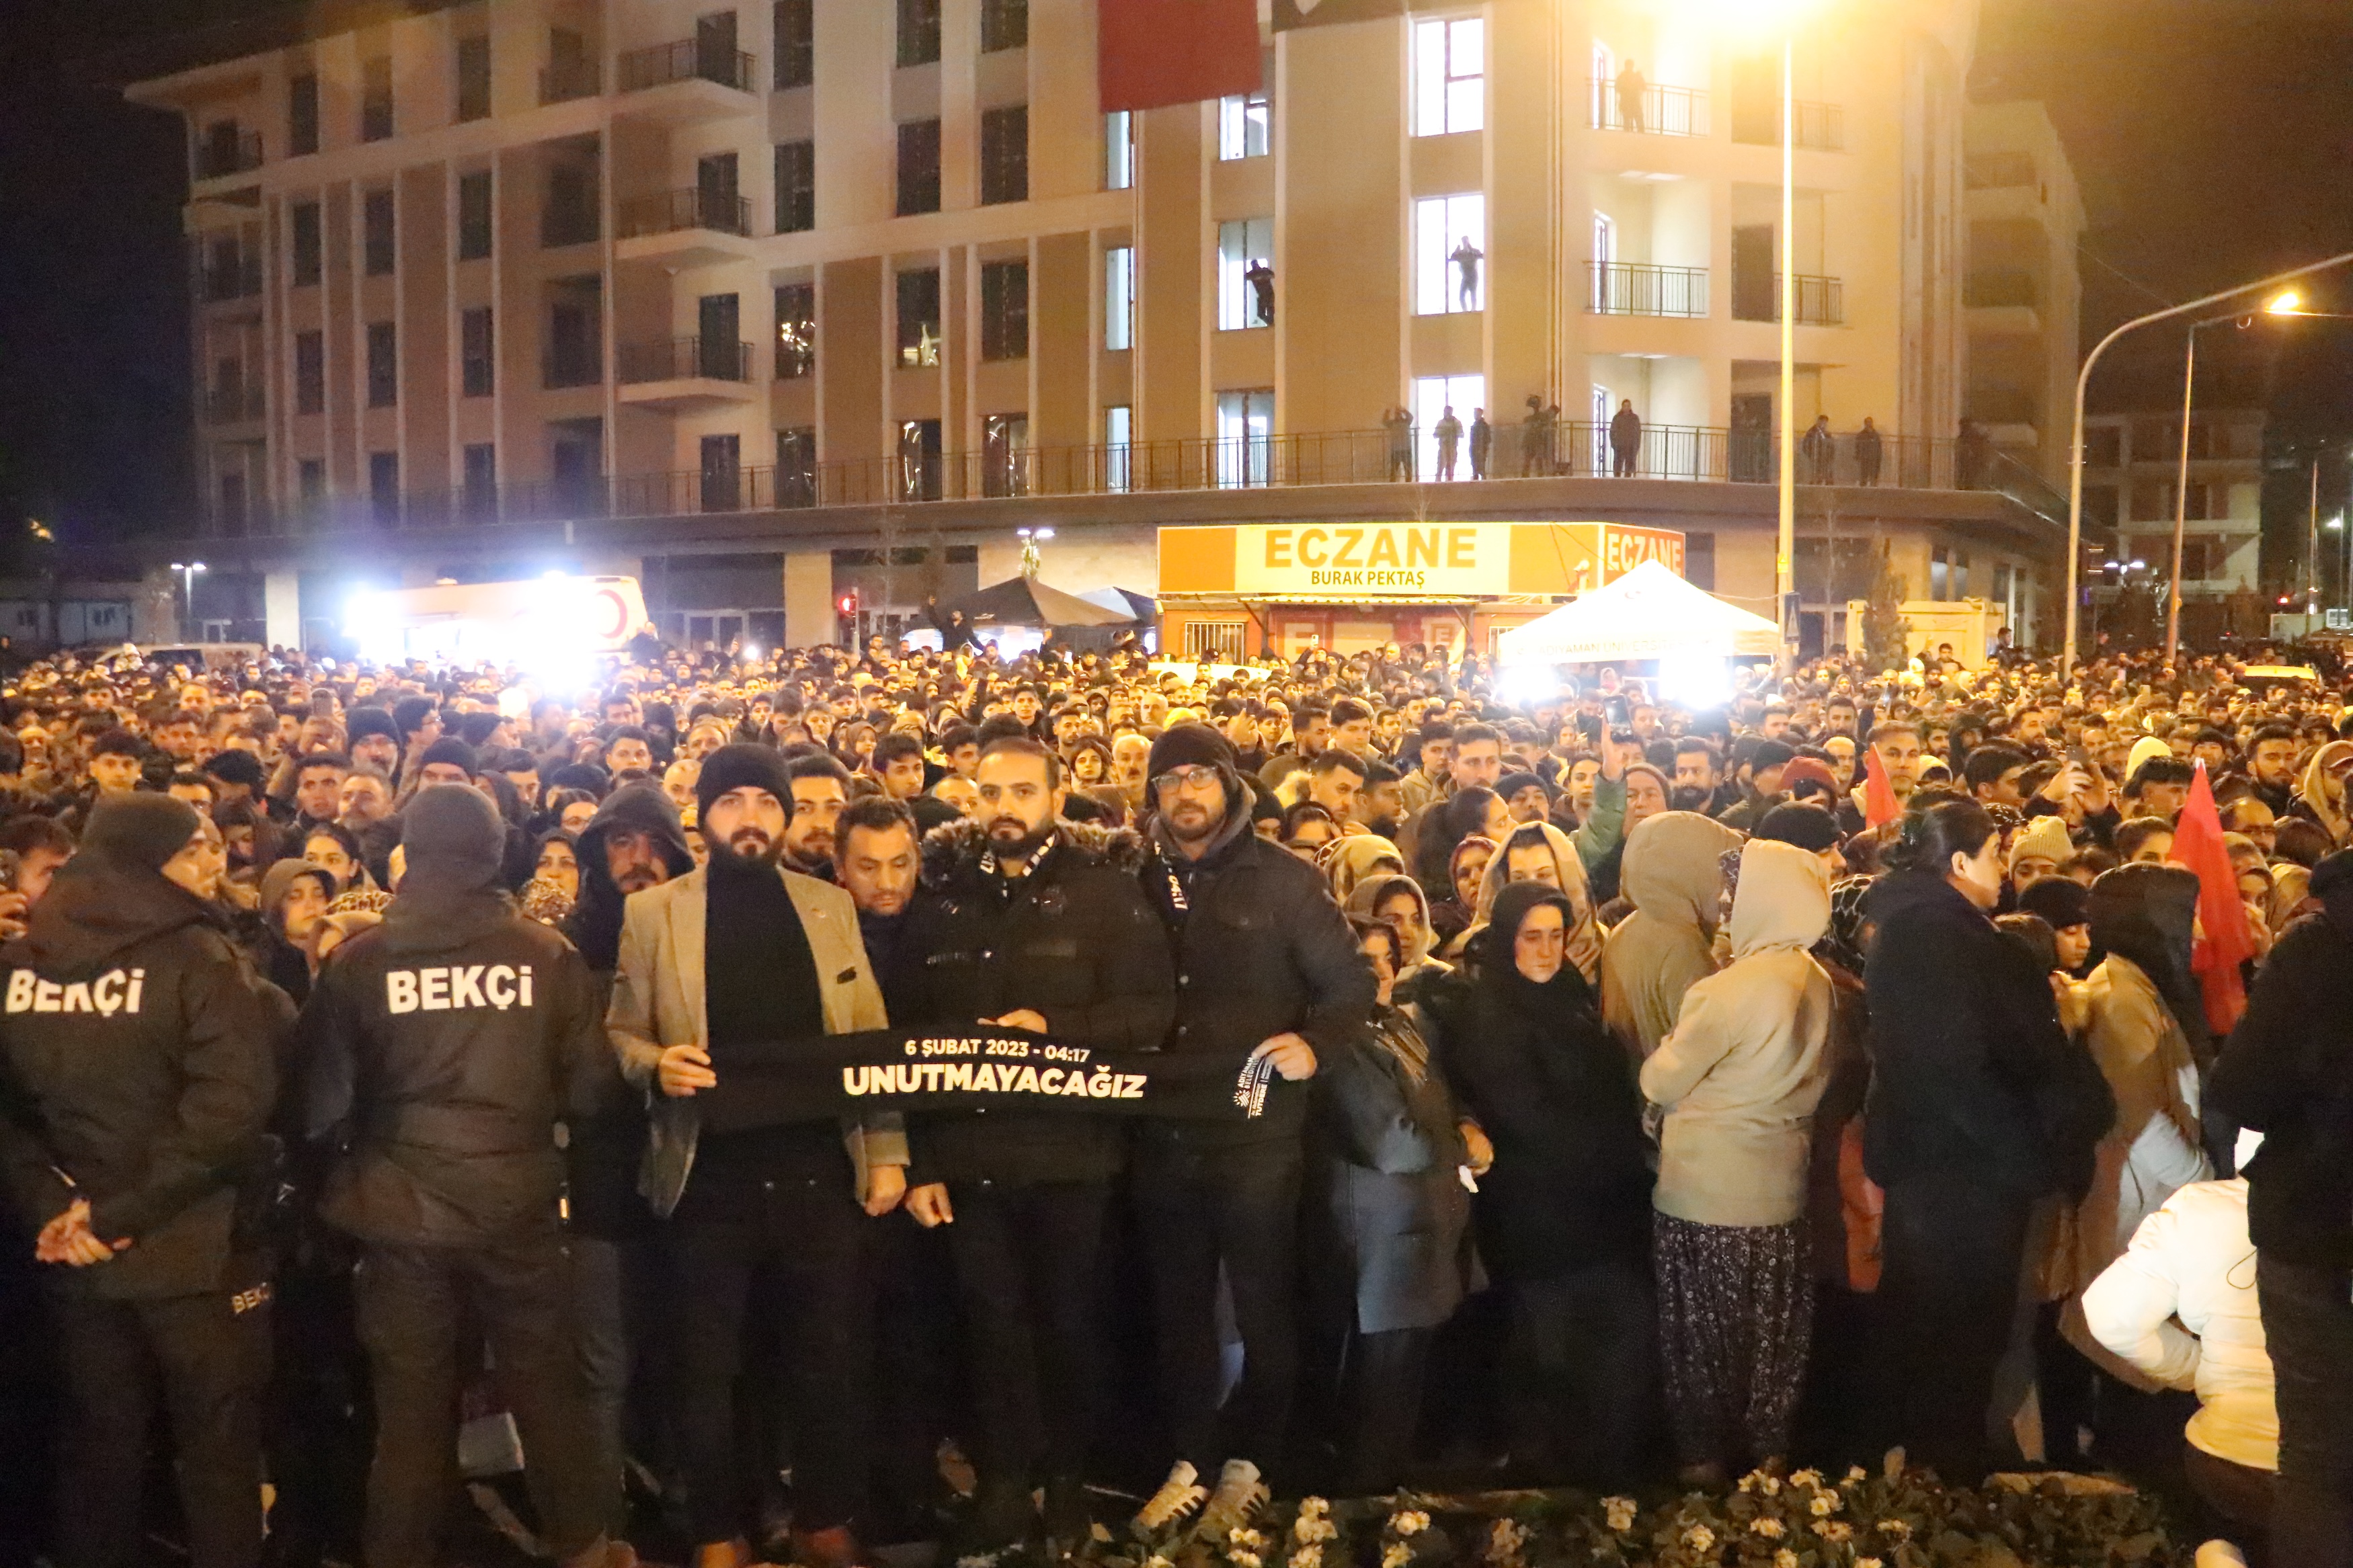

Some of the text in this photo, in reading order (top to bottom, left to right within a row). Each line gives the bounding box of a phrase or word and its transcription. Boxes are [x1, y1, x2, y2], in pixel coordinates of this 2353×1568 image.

[1265, 528, 1476, 568] ECZANE
[1607, 533, 1681, 577] ECZANE
[1312, 571, 1424, 589] BURAK PEKTAŞ
[1539, 643, 1599, 655] ADIYAMAN
[905, 1040, 917, 1055] 6
[922, 1039, 982, 1057] ŞUBAT
[985, 1039, 1029, 1057] 2023
[1045, 1044, 1090, 1063] 04:17
[843, 1063, 1147, 1098] UNUTMAYACAĞIZ
[1255, 1083, 1268, 1116] TUTDERE
